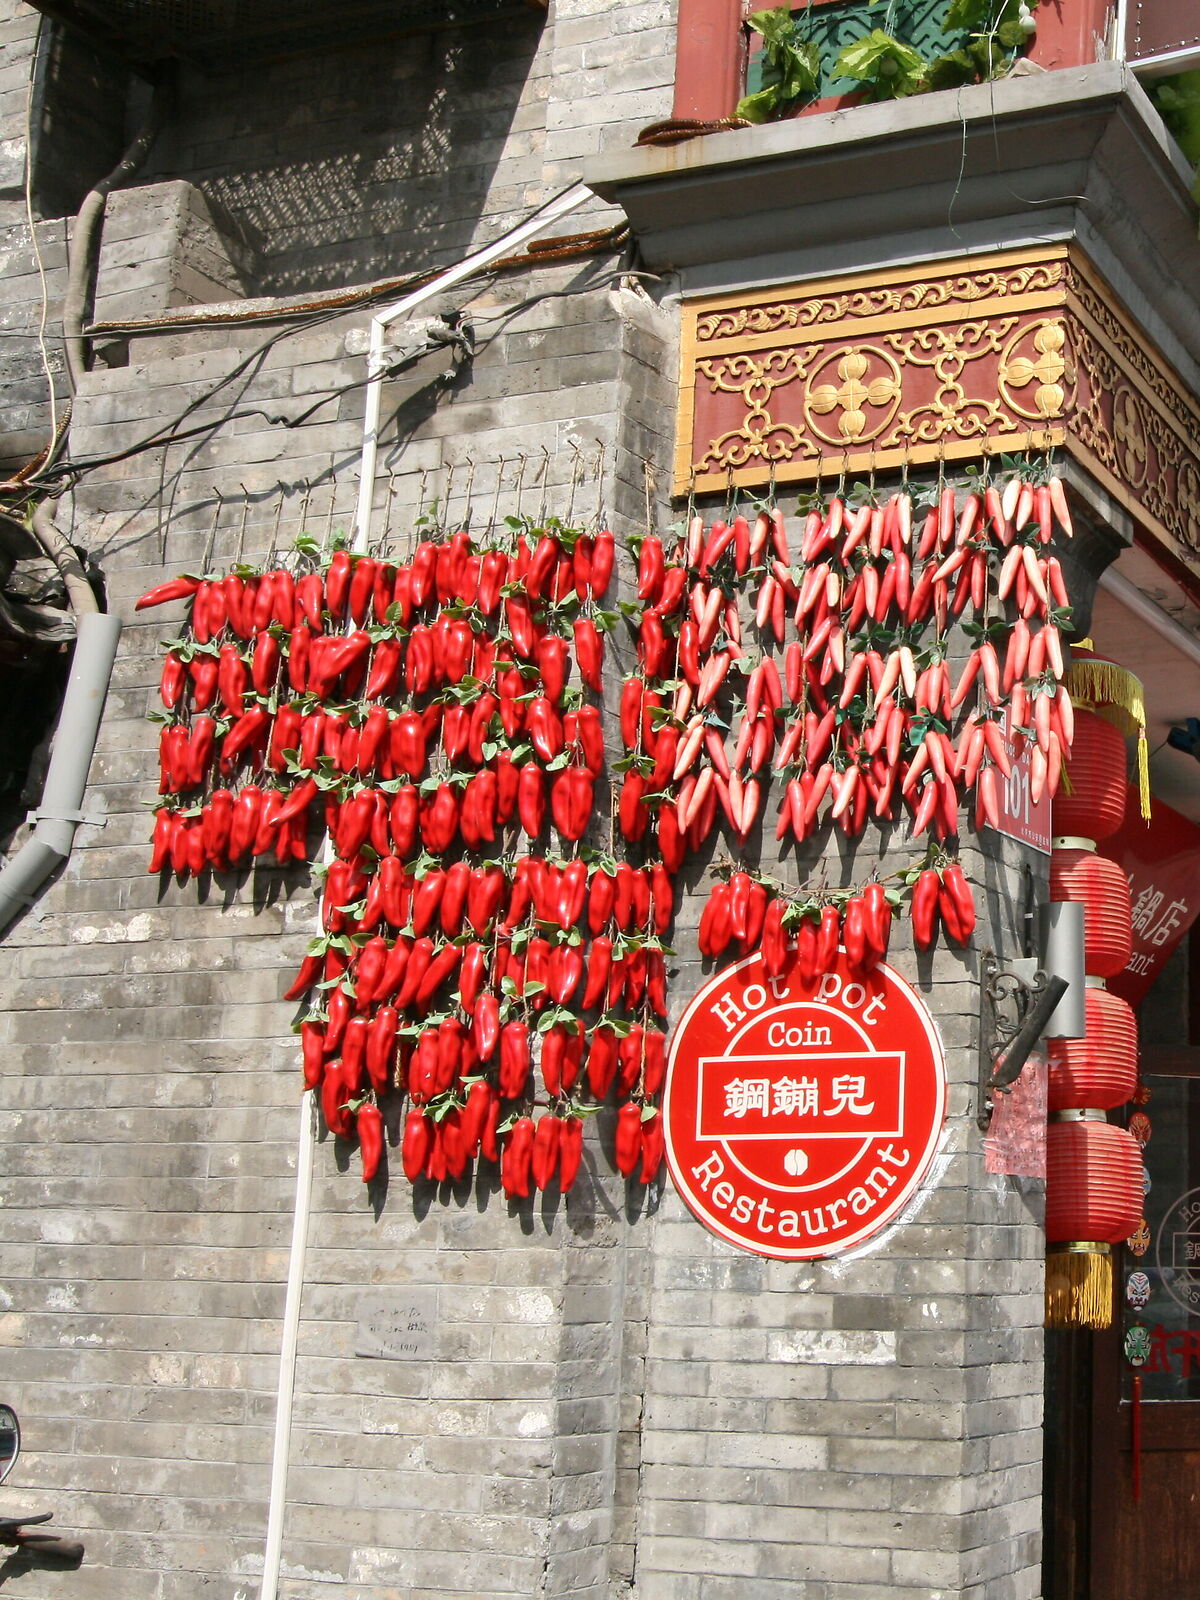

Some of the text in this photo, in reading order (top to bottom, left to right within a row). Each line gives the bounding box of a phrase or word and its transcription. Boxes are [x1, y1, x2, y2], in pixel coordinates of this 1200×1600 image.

[1127, 873, 1188, 946] 鍋店
[709, 973, 791, 1033] Hot
[767, 1021, 833, 1047] Coin
[691, 1143, 910, 1237] Restaurant
